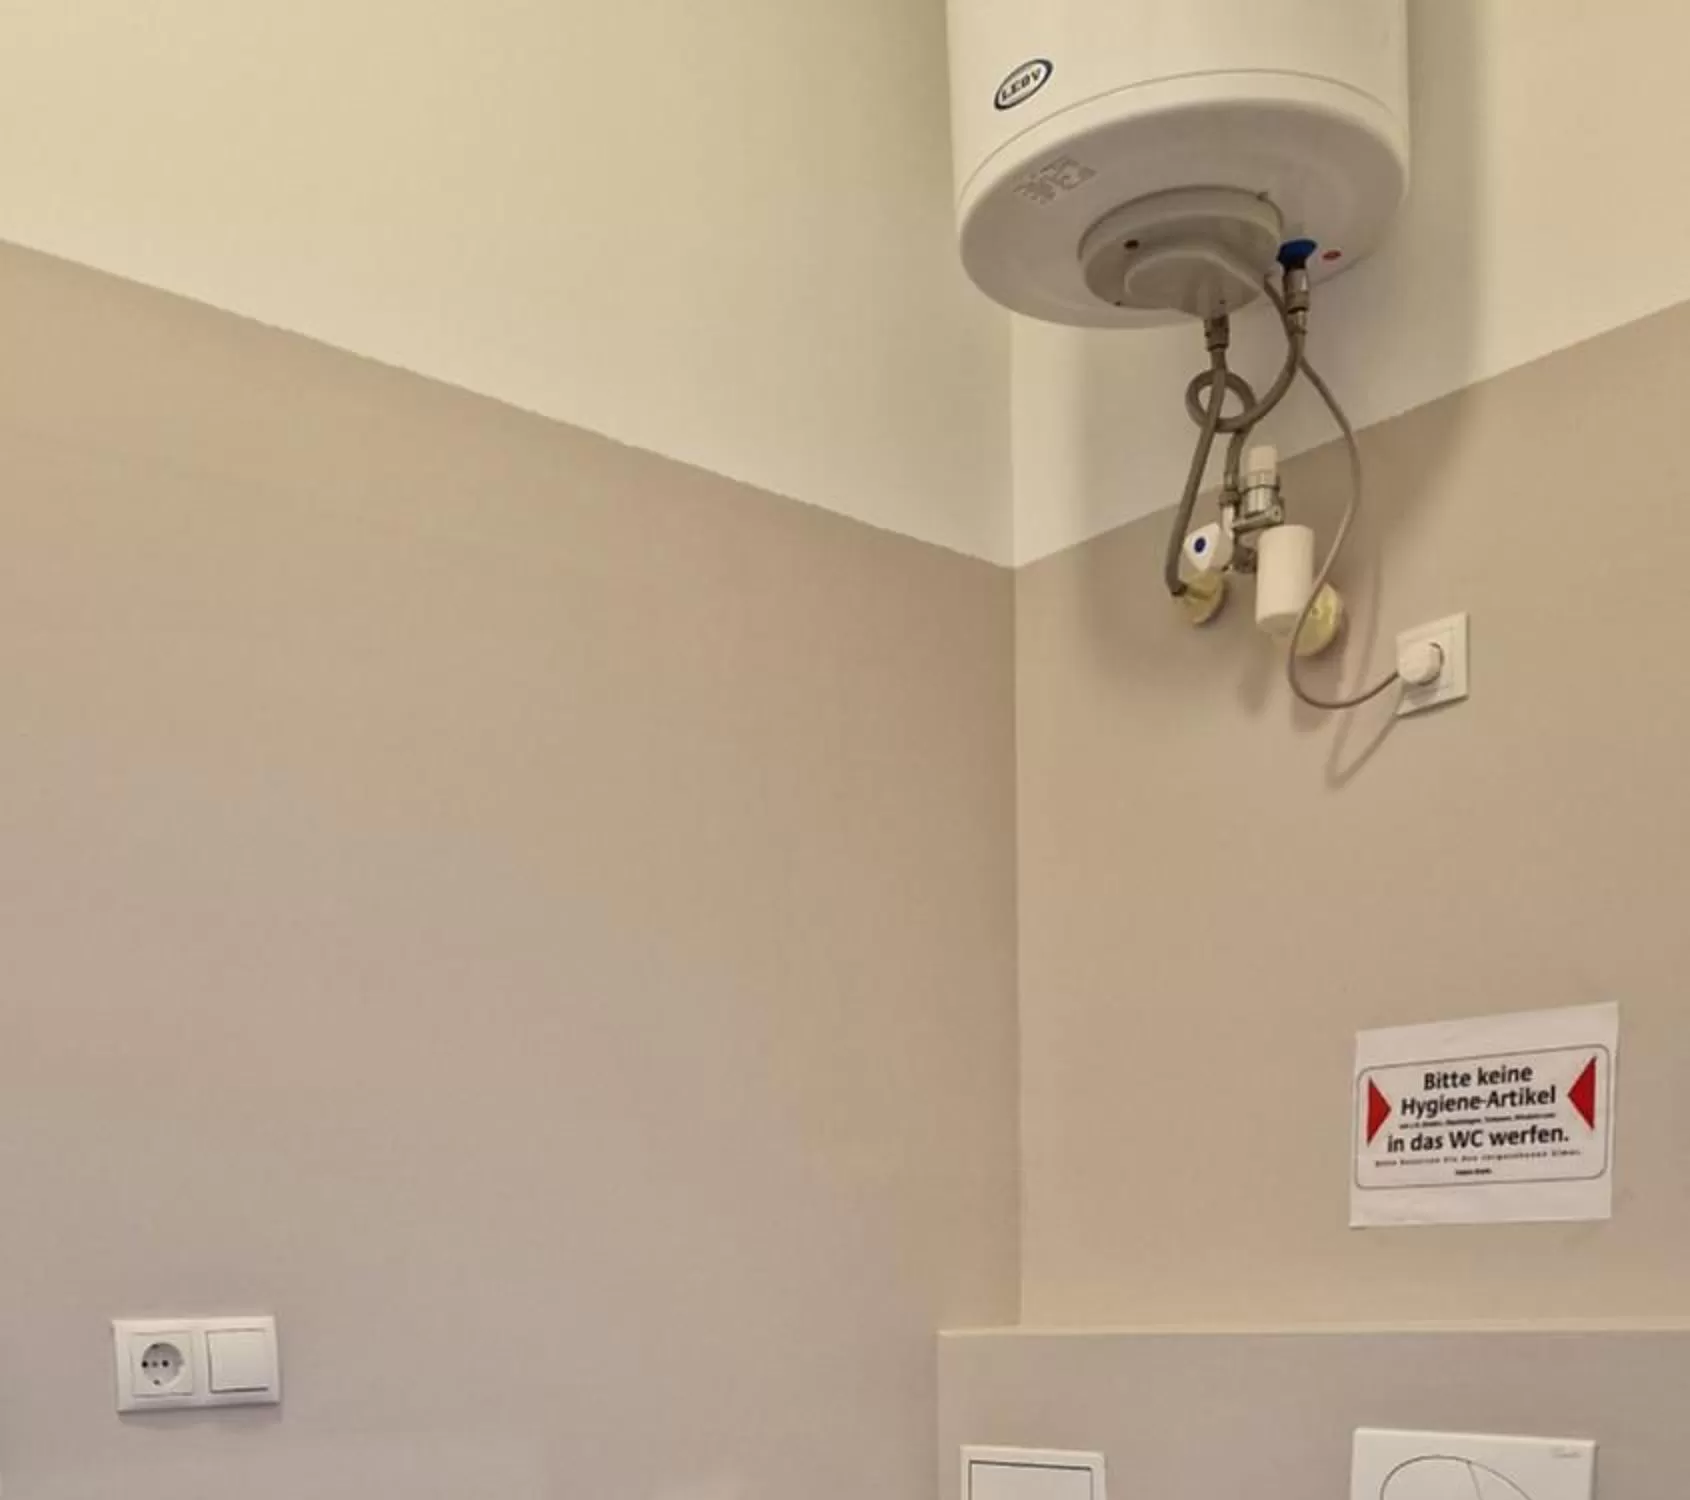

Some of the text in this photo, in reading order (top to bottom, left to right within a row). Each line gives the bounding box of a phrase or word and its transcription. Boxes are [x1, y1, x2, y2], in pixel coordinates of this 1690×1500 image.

[1424, 1066, 1533, 1091] Bitte keine
[1401, 1085, 1556, 1118] Hygiene-Artikel
[1387, 1124, 1569, 1152] in das WC werfen.
